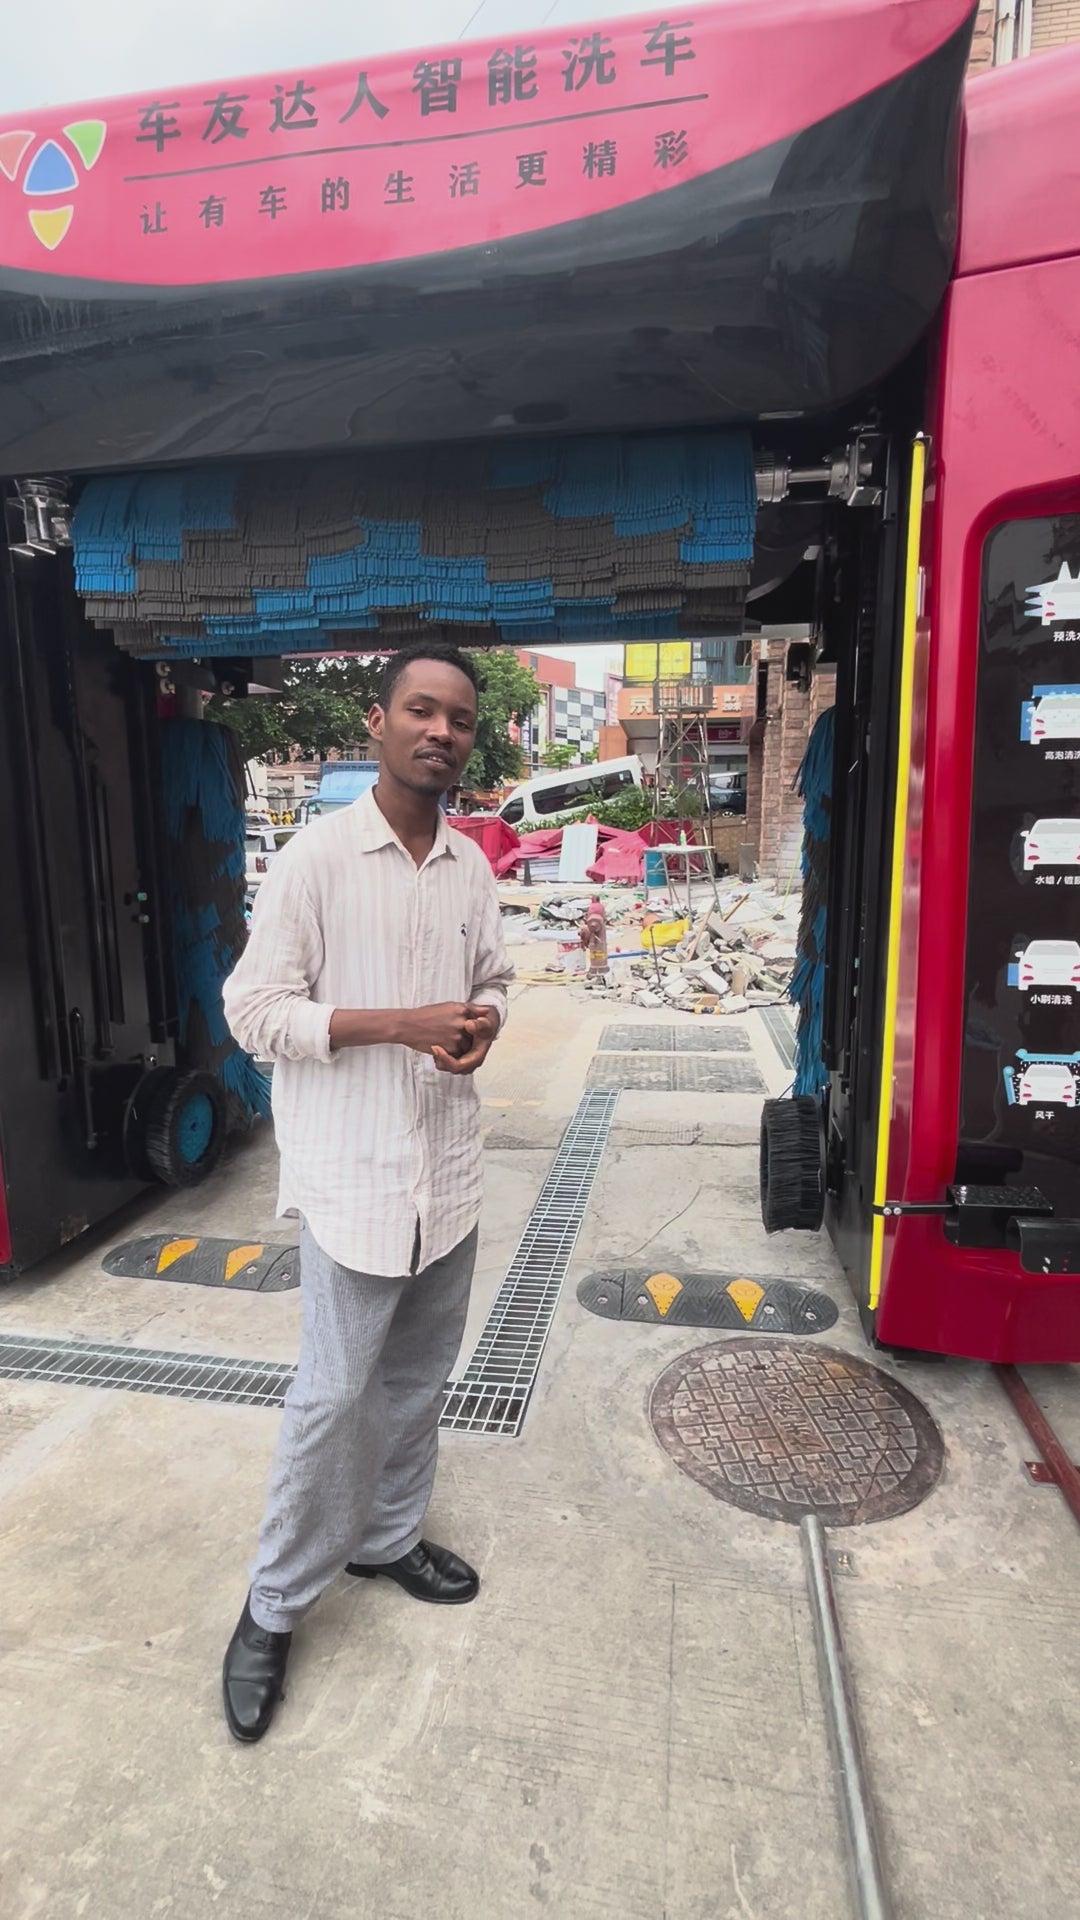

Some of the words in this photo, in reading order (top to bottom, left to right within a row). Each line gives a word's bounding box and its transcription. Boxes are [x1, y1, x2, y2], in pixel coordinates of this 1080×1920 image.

[135, 20, 697, 153] 车友达人智能洗车
[139, 129, 690, 235] 让有车的生活更精彩
[1030, 994, 1073, 1005] 小刷清洗
[1035, 1110, 1055, 1120] 风干
